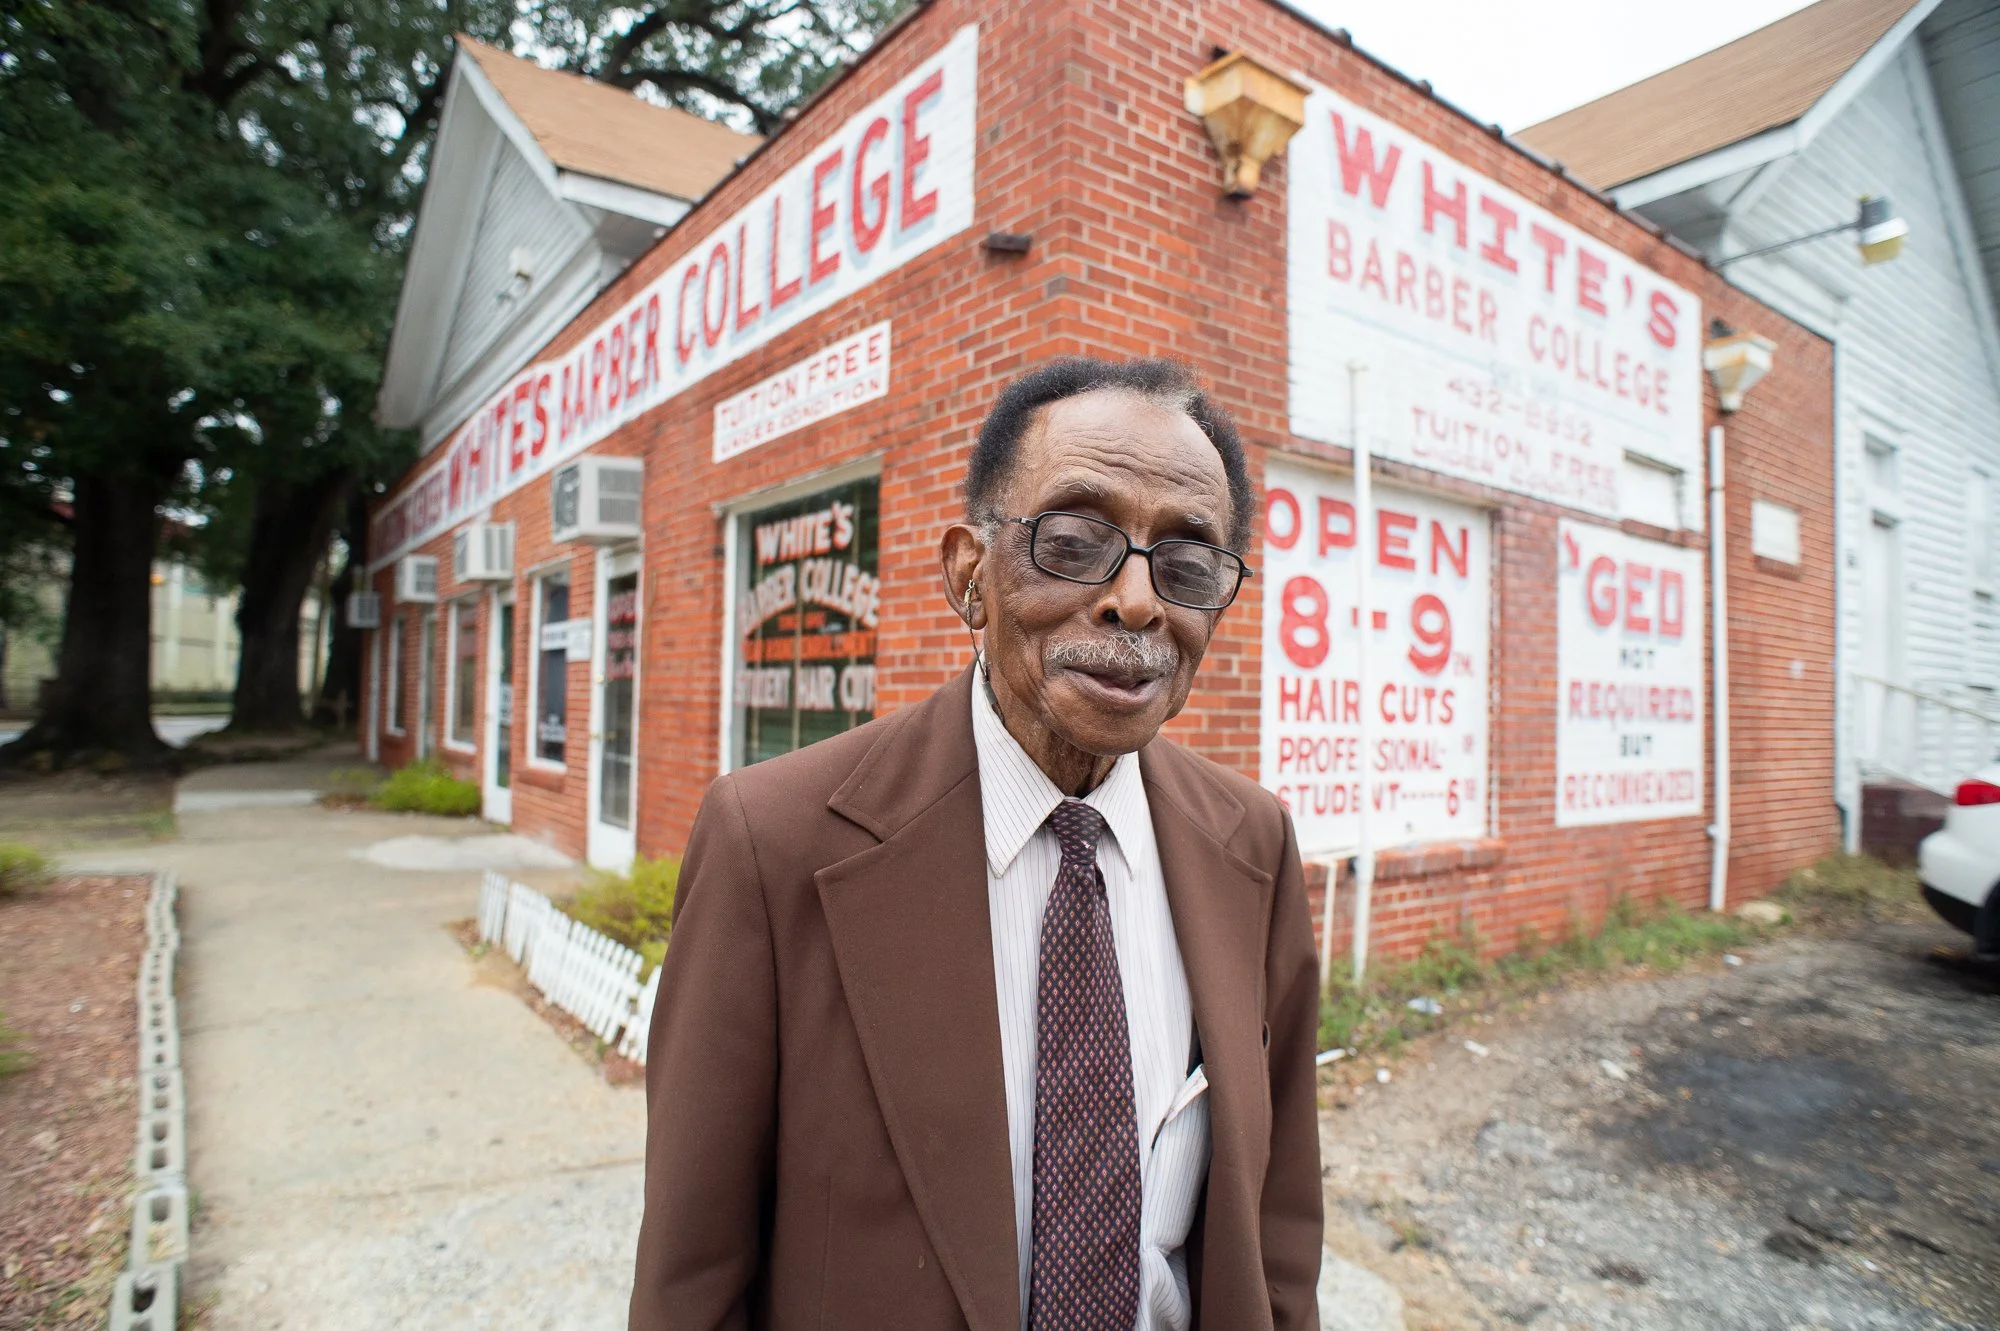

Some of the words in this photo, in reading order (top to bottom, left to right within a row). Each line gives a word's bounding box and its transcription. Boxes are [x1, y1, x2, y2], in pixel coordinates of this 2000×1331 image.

[560, 292, 661, 444] BARBER
[675, 68, 943, 366] COLLEGE
[1329, 109, 1679, 350] WHITE'S
[1327, 219, 1499, 344] BARBER
[1528, 313, 1672, 416] COLLEGE
[720, 371, 800, 431] TUITION
[806, 331, 884, 397] FREE
[1411, 405, 1531, 467] TUITION
[755, 501, 854, 566] WHITE'S
[1265, 488, 1469, 579] OPEN
[799, 558, 880, 630] COLLEGE
[1586, 554, 1685, 638] GED
[1279, 676, 1361, 725] HAIR
[1380, 682, 1456, 725] CUTS
[1568, 680, 1694, 732] REQUIRED
[1620, 733, 1653, 758] BUT
